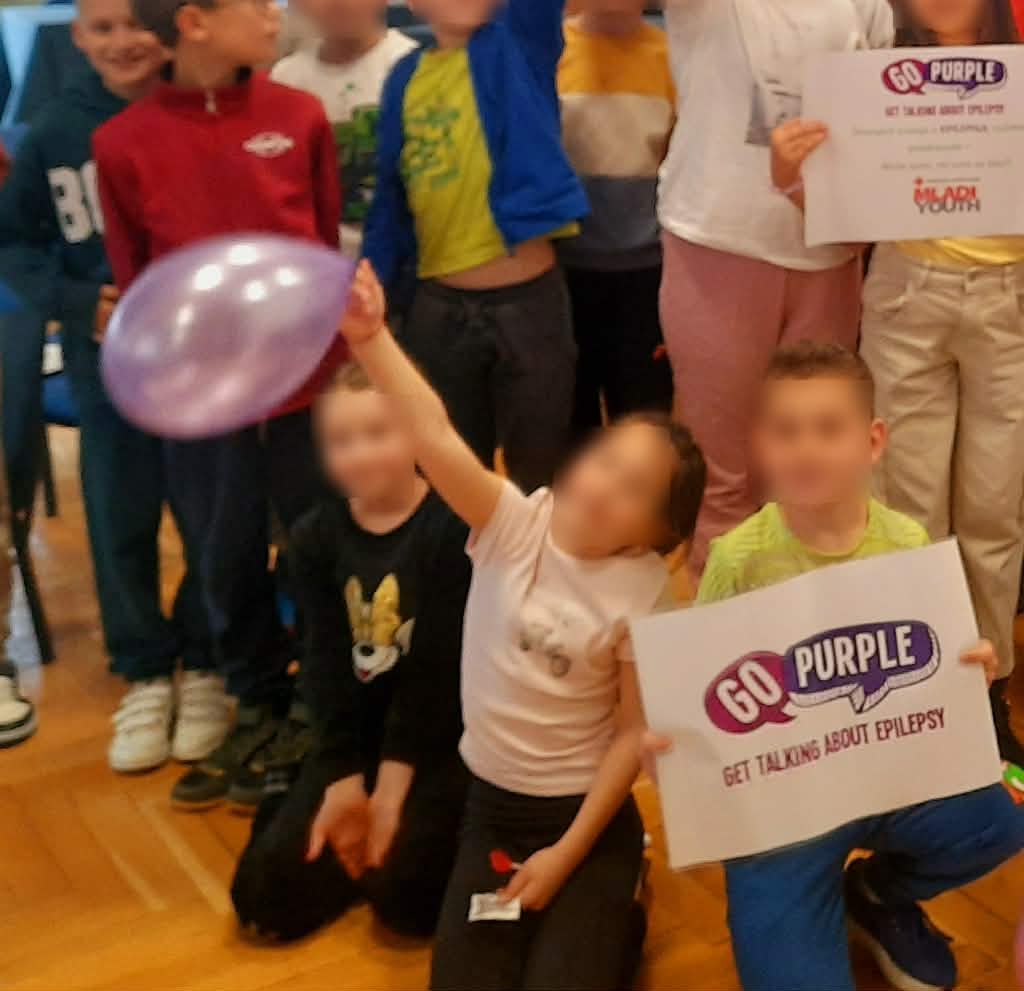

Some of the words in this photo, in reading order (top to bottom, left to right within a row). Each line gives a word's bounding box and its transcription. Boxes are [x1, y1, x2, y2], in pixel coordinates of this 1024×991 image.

[887, 61, 923, 91] GO
[930, 61, 996, 82] PURPLE
[913, 185, 977, 203] MLADI
[914, 199, 981, 215] YOUTH
[716, 661, 783, 725] GO
[794, 625, 917, 689] PURPLE
[722, 760, 752, 788] GET
[756, 739, 821, 776] TALKING
[823, 723, 871, 756] ABOUT
[875, 707, 945, 741] EPILEPSY
